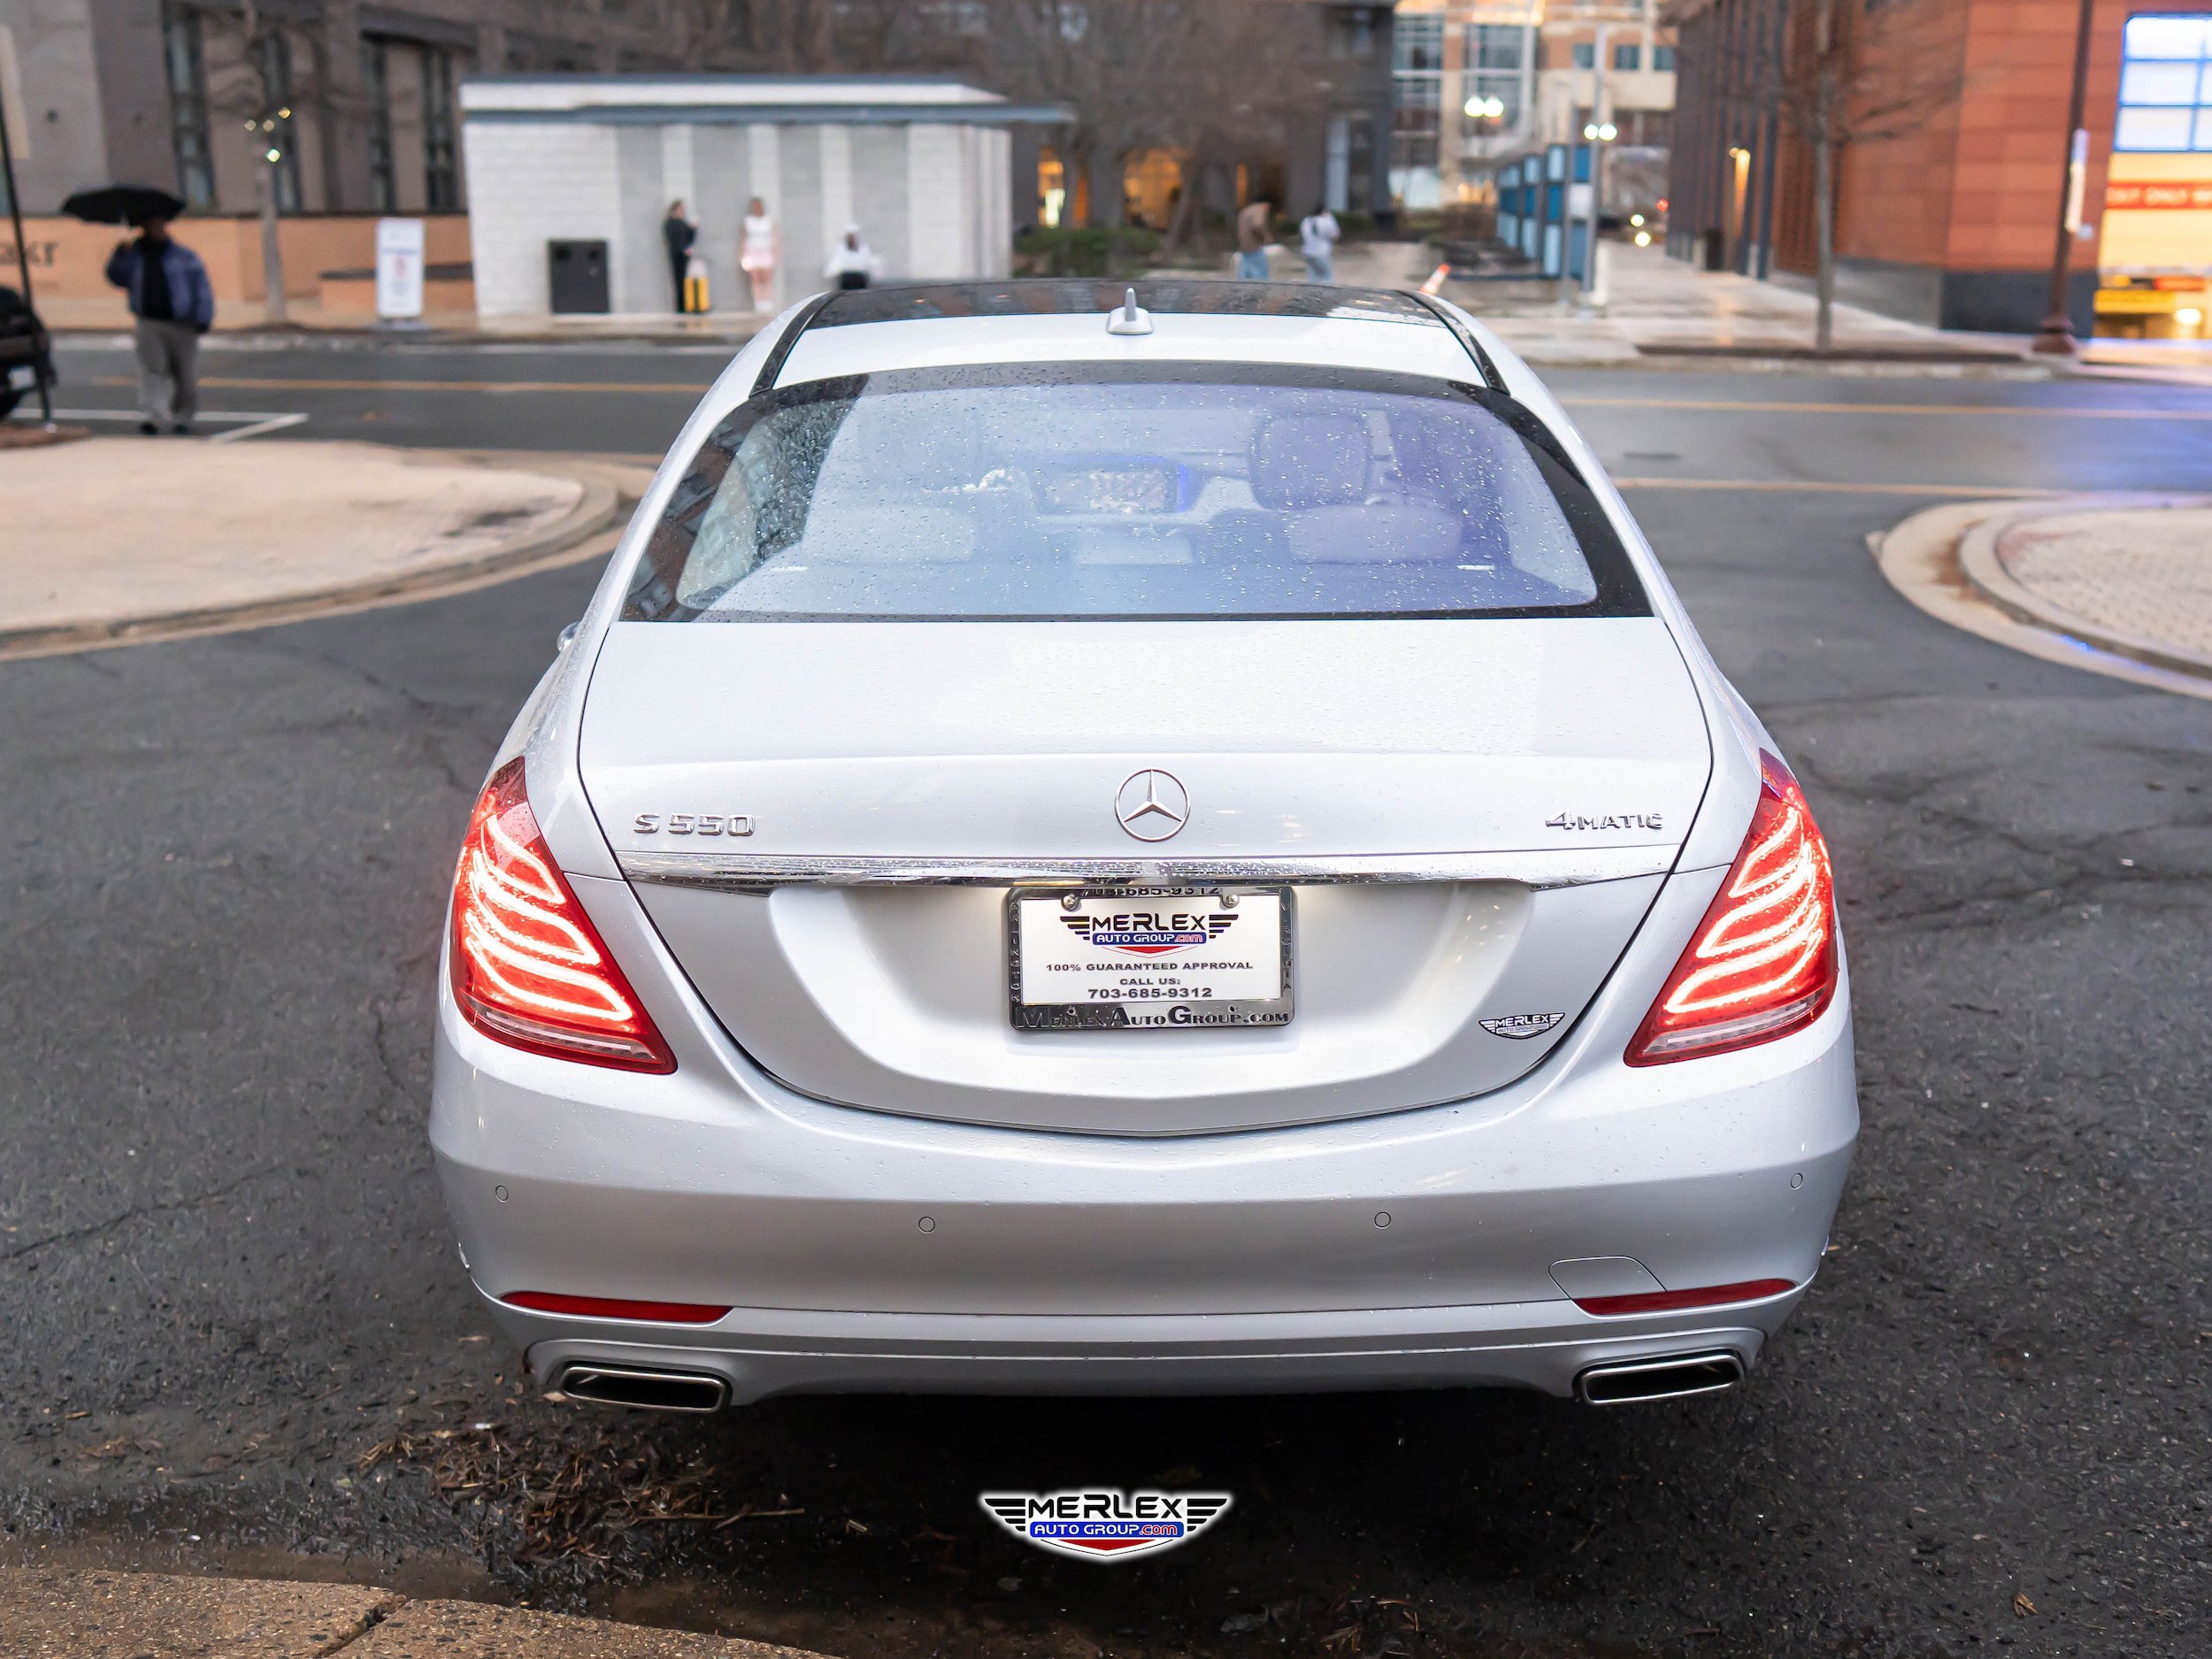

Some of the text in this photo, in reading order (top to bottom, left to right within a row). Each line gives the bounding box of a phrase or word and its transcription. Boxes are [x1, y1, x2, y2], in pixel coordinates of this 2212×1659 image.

[634, 812, 756, 836] S 550
[1545, 809, 1663, 830] 4MATIC
[1092, 913, 1206, 932] MERLEX
[1087, 987, 1212, 999] 703-685-9312
[1495, 1015, 1549, 1028] MERLEX
